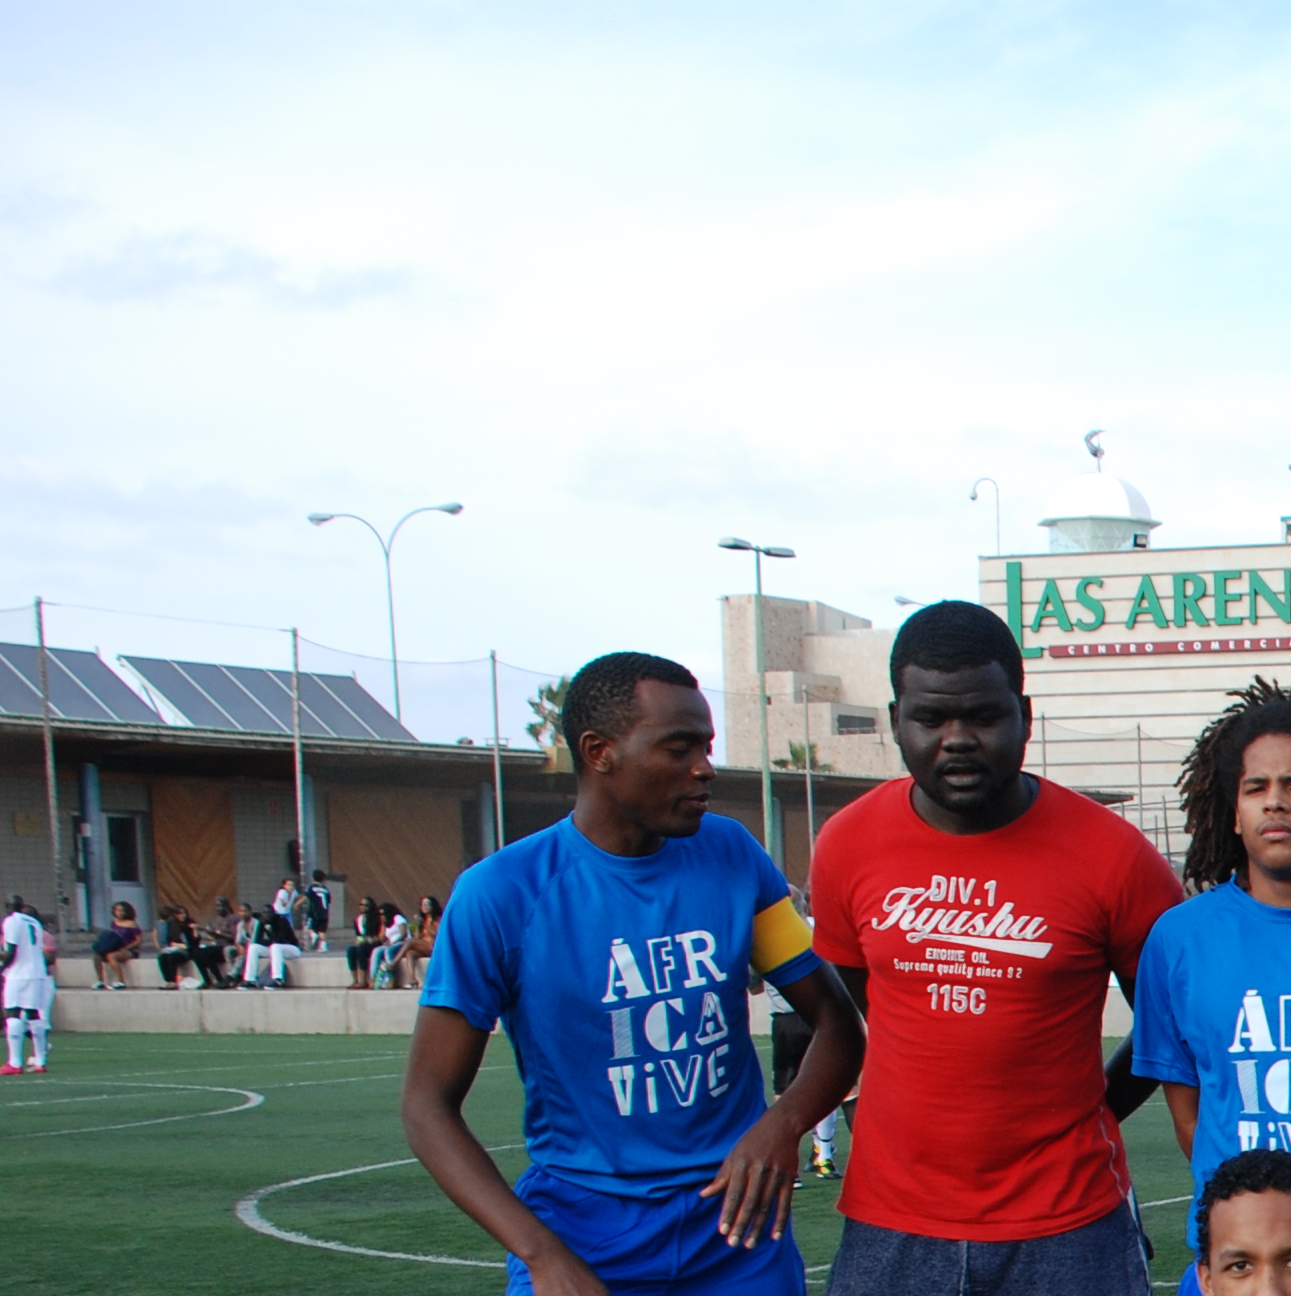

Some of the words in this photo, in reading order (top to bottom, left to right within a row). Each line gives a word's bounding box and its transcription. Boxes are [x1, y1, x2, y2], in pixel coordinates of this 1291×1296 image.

[1006, 562, 1105, 658] LAS
[1068, 642, 1154, 656] CENTRO
[929, 875, 997, 907] DIV.1
[871, 887, 1049, 944] Kyushu
[893, 958, 935, 972] Supreme
[937, 962, 973, 978] quality
[976, 966, 1003, 978] since
[925, 947, 966, 962] ENGINE
[971, 951, 990, 964] OIL
[926, 983, 987, 1015] 115C
[605, 992, 728, 1060] ICA
